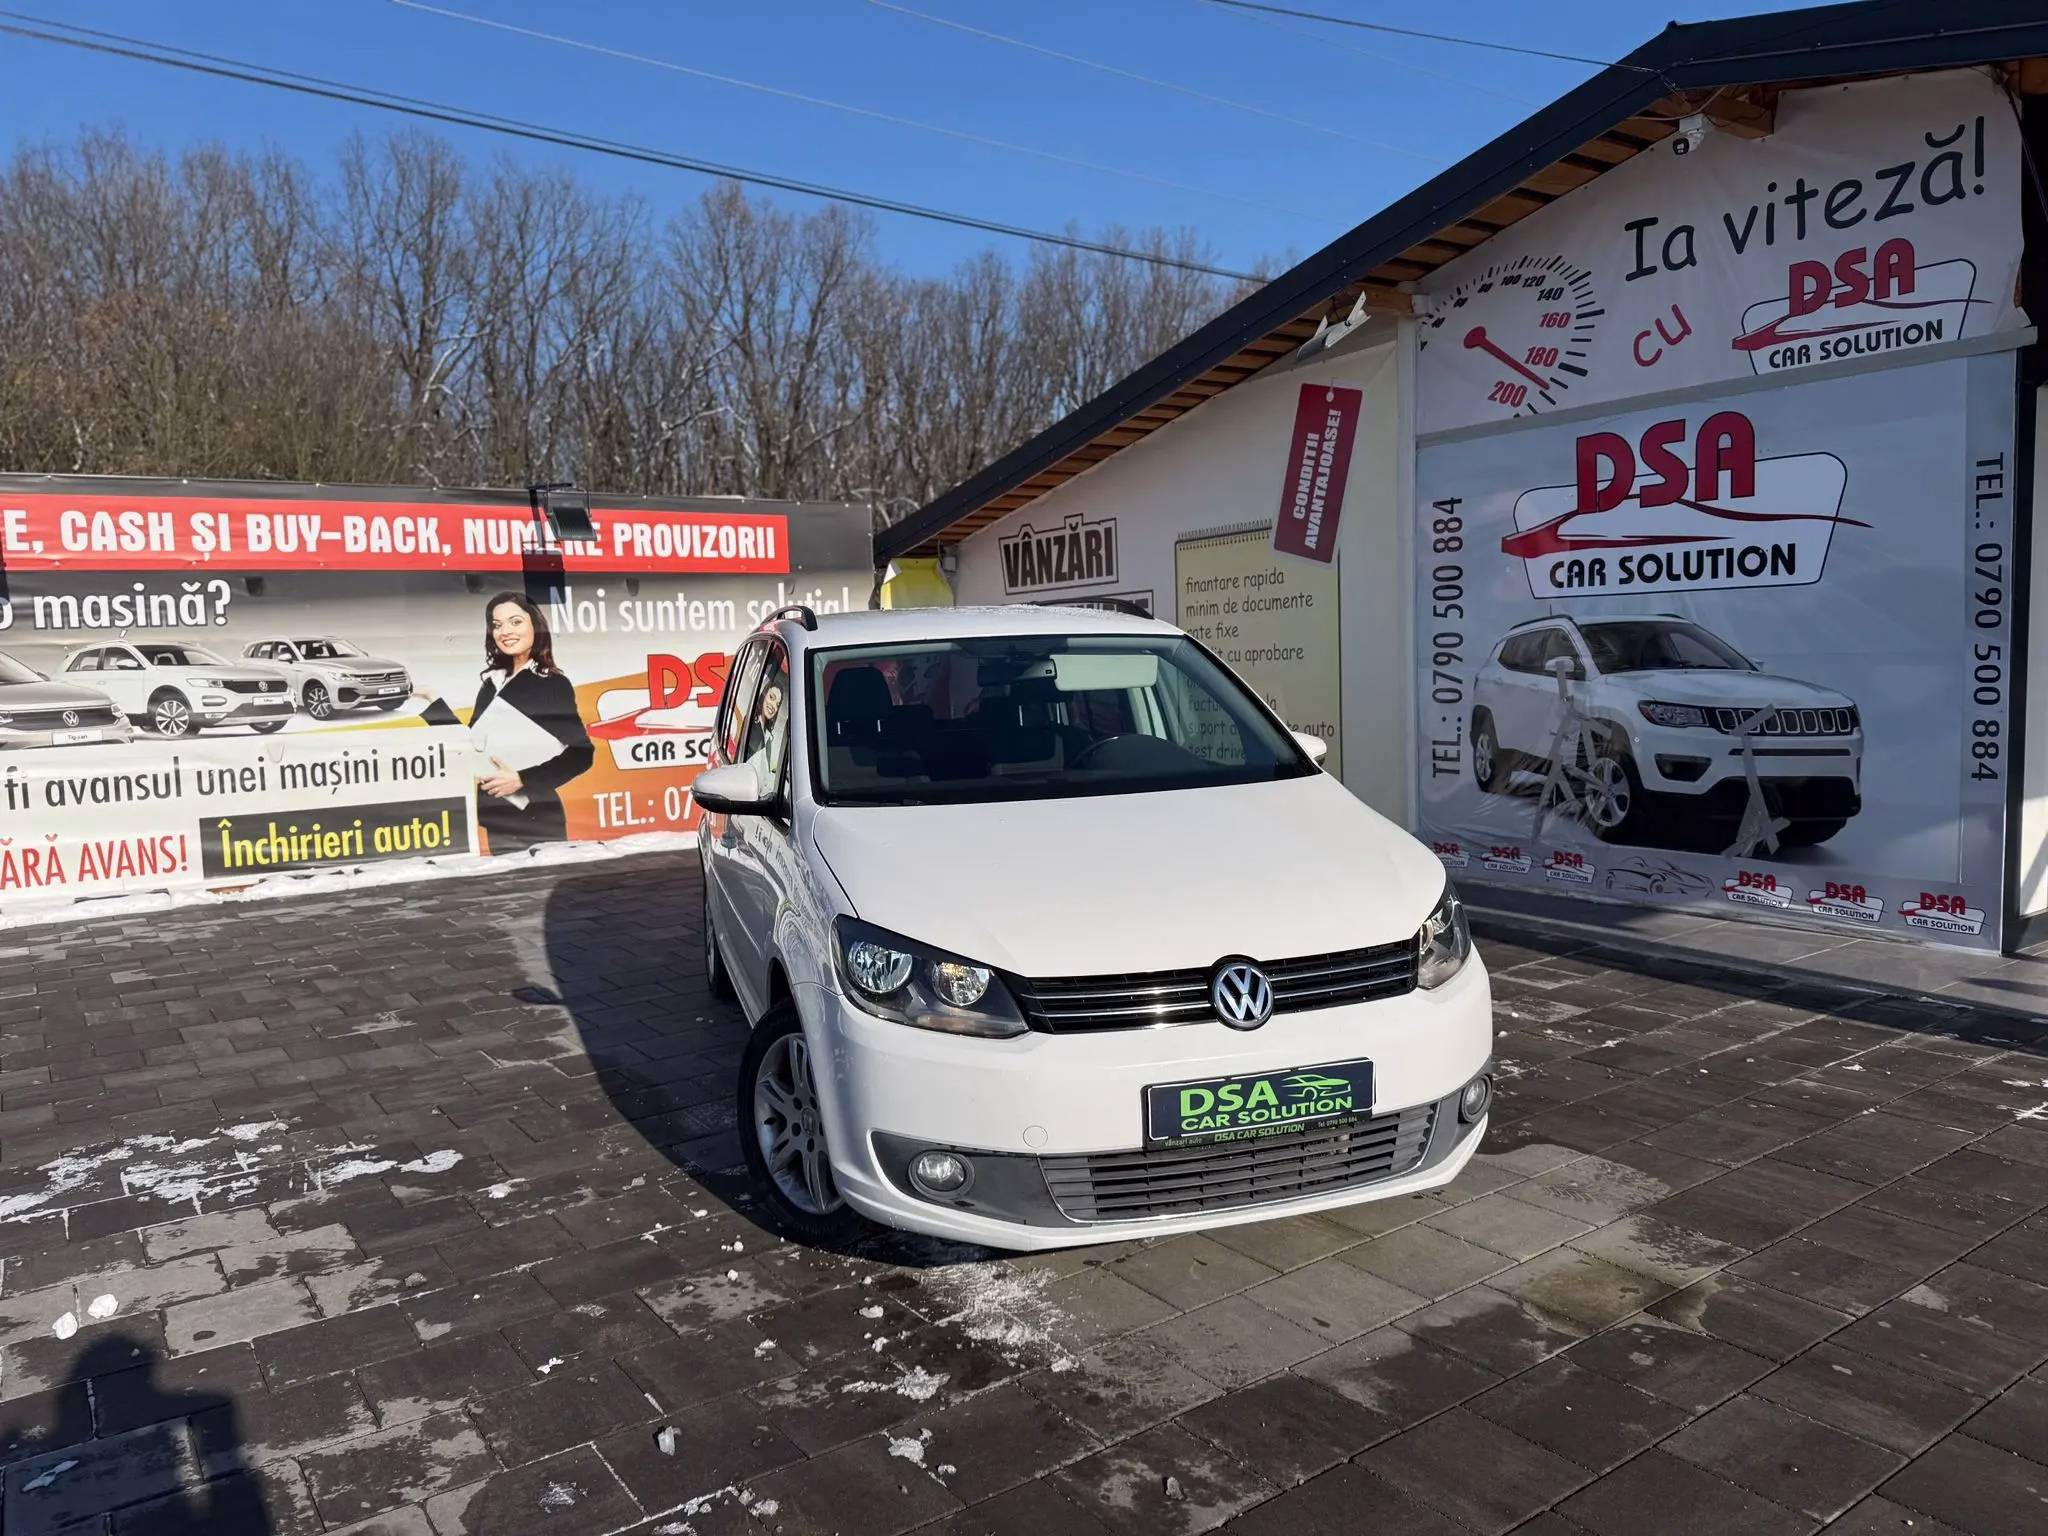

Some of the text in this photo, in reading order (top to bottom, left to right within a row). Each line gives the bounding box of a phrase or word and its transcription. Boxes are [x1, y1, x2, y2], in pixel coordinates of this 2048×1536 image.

[1623, 115, 1985, 282] Ia viteză!
[1522, 275, 1546, 288] 120
[1536, 287, 1565, 302] 140
[1789, 237, 1915, 317] DSA
[1538, 312, 1572, 329] 160
[1633, 303, 1692, 367] cu
[1768, 318, 1943, 369] CAR SOLUTION
[1524, 346, 1559, 368] 180
[1487, 380, 1528, 408] 200
[1293, 432, 1320, 520] CONDITII
[1304, 409, 1342, 550] AVANTAJOASE!
[1576, 410, 1756, 515] DSA
[60, 511, 175, 553] CASH
[246, 514, 452, 557] BUY-BACK,
[613, 522, 776, 560] PROVIZORII
[1432, 496, 1463, 554] 884
[1003, 522, 1114, 588] VÂNZĂRI
[1549, 542, 1796, 589] CAR SOLUTION
[1185, 567, 1284, 594] finantare rapida
[1186, 592, 1313, 617] minim de documente
[1432, 564, 1464, 620] 500
[1974, 542, 2003, 629] 0790
[33, 579, 231, 639] mașină?
[550, 586, 606, 634] Noi
[620, 592, 736, 633] suntem
[1216, 622, 1239, 639] fixe
[1227, 650, 1241, 662] cu
[1245, 643, 1304, 666] aprobare
[1432, 631, 1464, 704] 0790
[1973, 643, 2002, 706] 500
[647, 652, 725, 711] DS
[631, 738, 676, 763] CAR
[1971, 718, 2000, 782] 884
[45, 756, 182, 808] avansul
[196, 757, 266, 796] unei
[280, 749, 380, 795] mașini
[392, 743, 447, 781] noi!
[593, 791, 655, 828] TEL.:
[78, 834, 188, 883] AVANS!
[217, 809, 451, 869] Închirieri auto!
[1738, 870, 1777, 892] DSA
[1825, 881, 1866, 904] DSA
[1919, 892, 1966, 915] DSA
[1818, 905, 1874, 921] CAR SOLUTION
[1912, 917, 1975, 934] CAR SOLUTION
[1180, 1080, 1279, 1117] DSA
[1181, 1096, 1352, 1131] CAR SOLUTION
[1214, 1123, 1305, 1142] DSA CAR SOLUTION
